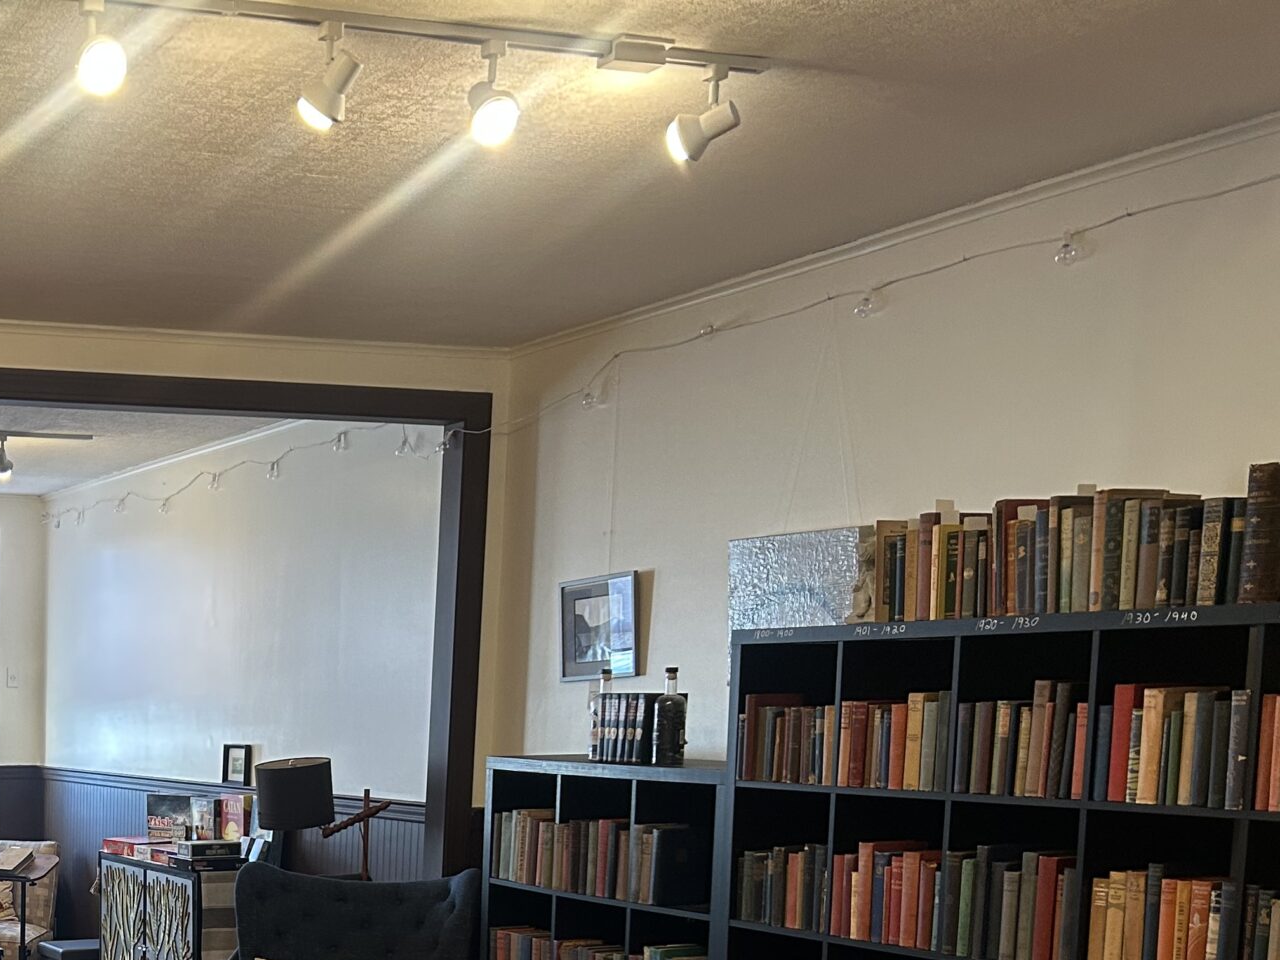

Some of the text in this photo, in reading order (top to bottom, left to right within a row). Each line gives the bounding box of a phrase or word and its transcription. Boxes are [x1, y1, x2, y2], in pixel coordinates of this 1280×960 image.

[1165, 611, 1198, 623] 1940
[1012, 617, 1039, 630] 1930
[223, 800, 241, 814] CATAN
[148, 816, 173, 828] Risk
